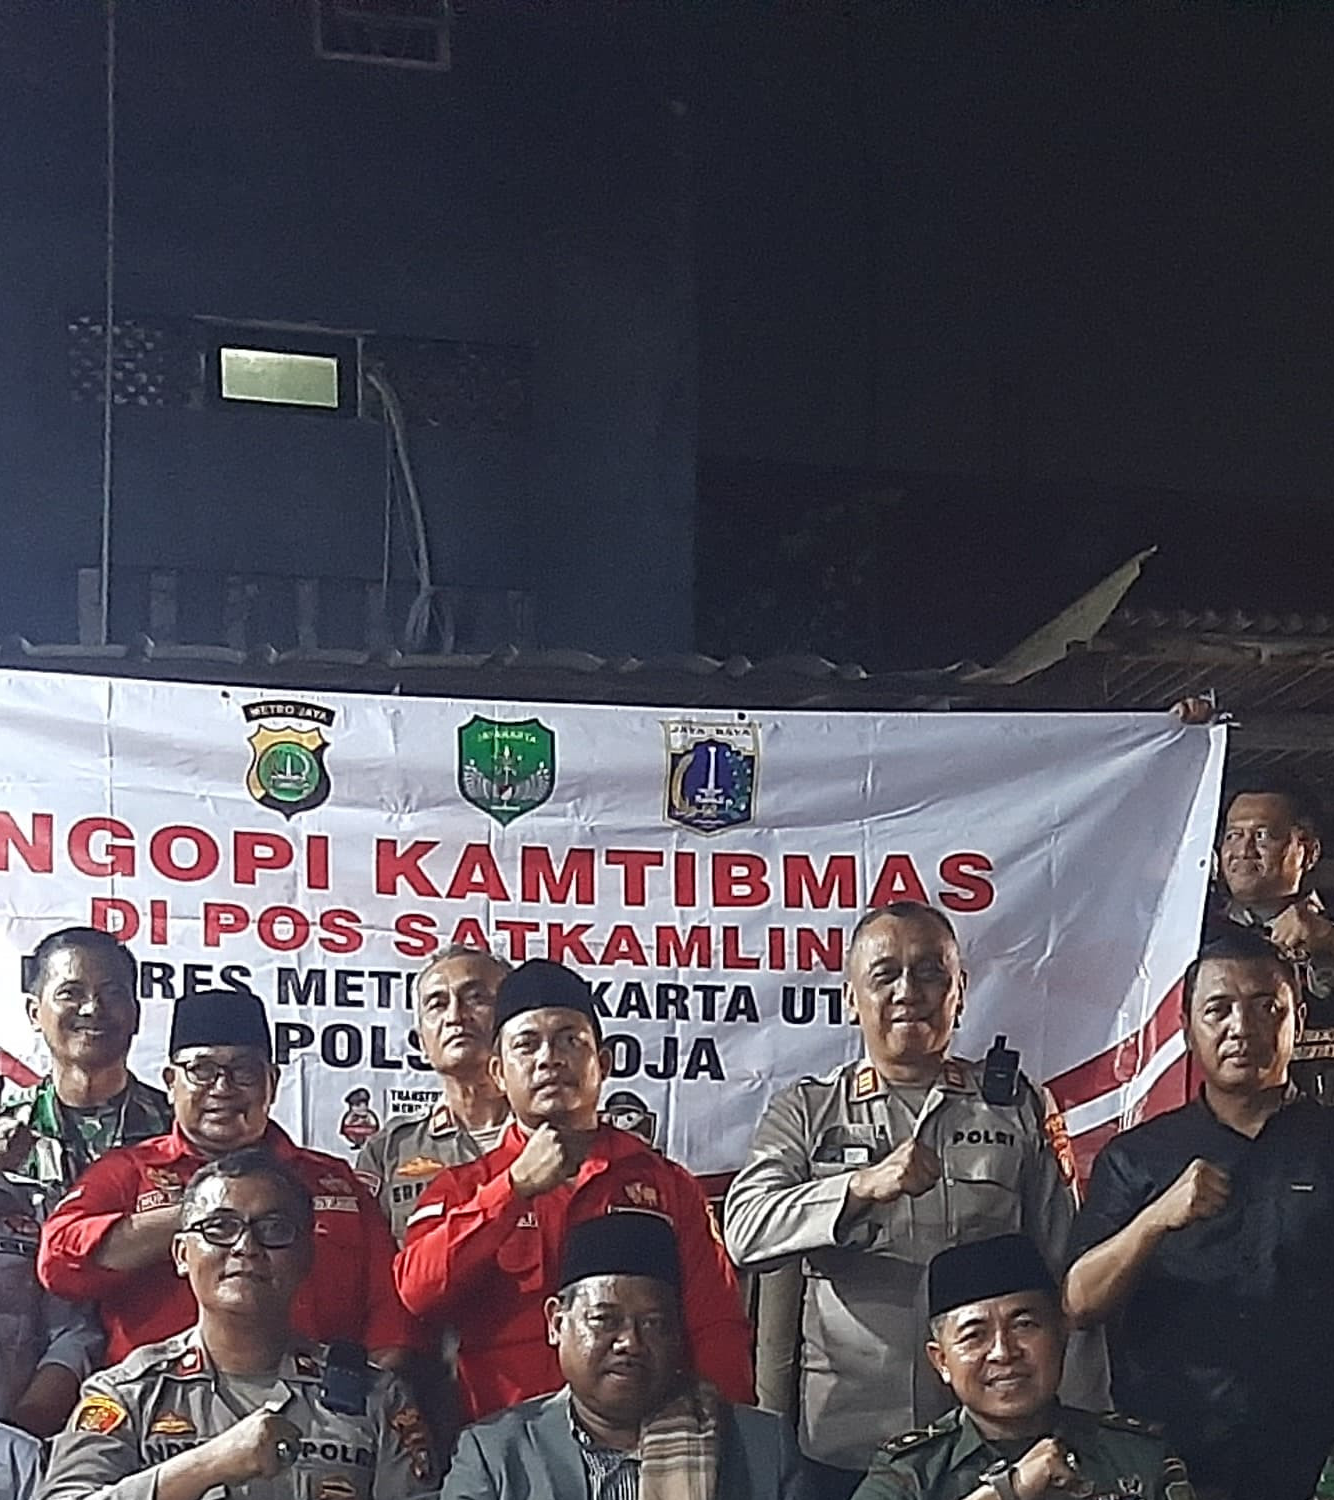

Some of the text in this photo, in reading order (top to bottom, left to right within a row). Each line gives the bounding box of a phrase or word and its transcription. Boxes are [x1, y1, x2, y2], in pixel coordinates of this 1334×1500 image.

[249, 704, 295, 718] METRO
[670, 726, 751, 737] JAYA RAYA
[375, 837, 997, 913] KAMTIBMAS
[90, 896, 844, 972] DI POS SATKAMLIN
[277, 967, 418, 1010] MET
[585, 980, 760, 1023] KARTA
[602, 1033, 726, 1081] OJA
[953, 1130, 1015, 1147] POLRI
